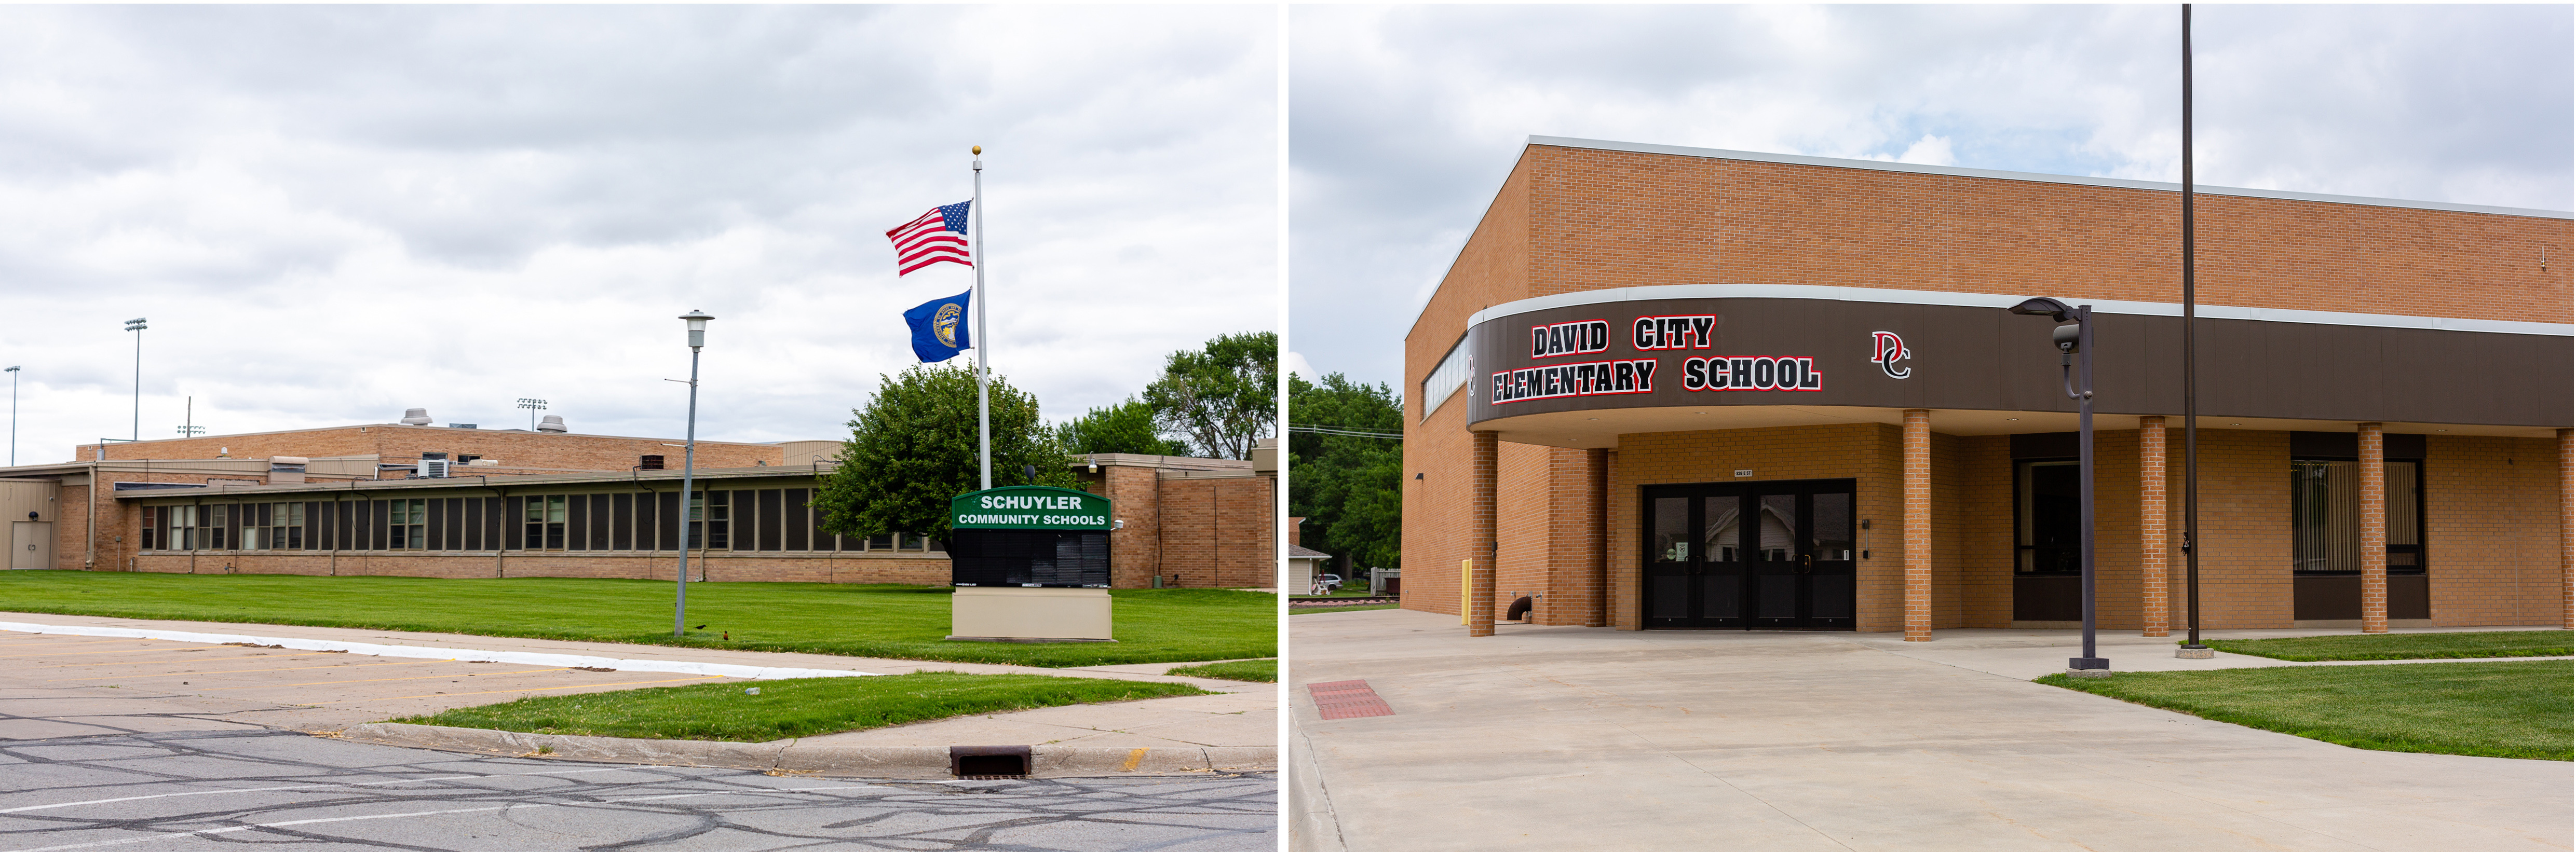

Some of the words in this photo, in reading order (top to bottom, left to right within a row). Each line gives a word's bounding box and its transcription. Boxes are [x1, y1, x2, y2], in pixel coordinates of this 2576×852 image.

[1532, 319, 1610, 359] DAVID
[1632, 314, 1716, 351] CITY
[1871, 331, 1911, 379] DC
[1492, 358, 1657, 405] ELEMENTARY
[1683, 355, 1822, 391] SCHOOL
[959, 514, 1039, 525] COMMUNITY
[1043, 515, 1105, 525] SCHOOLS
[981, 496, 1082, 510] SCHUYLER
